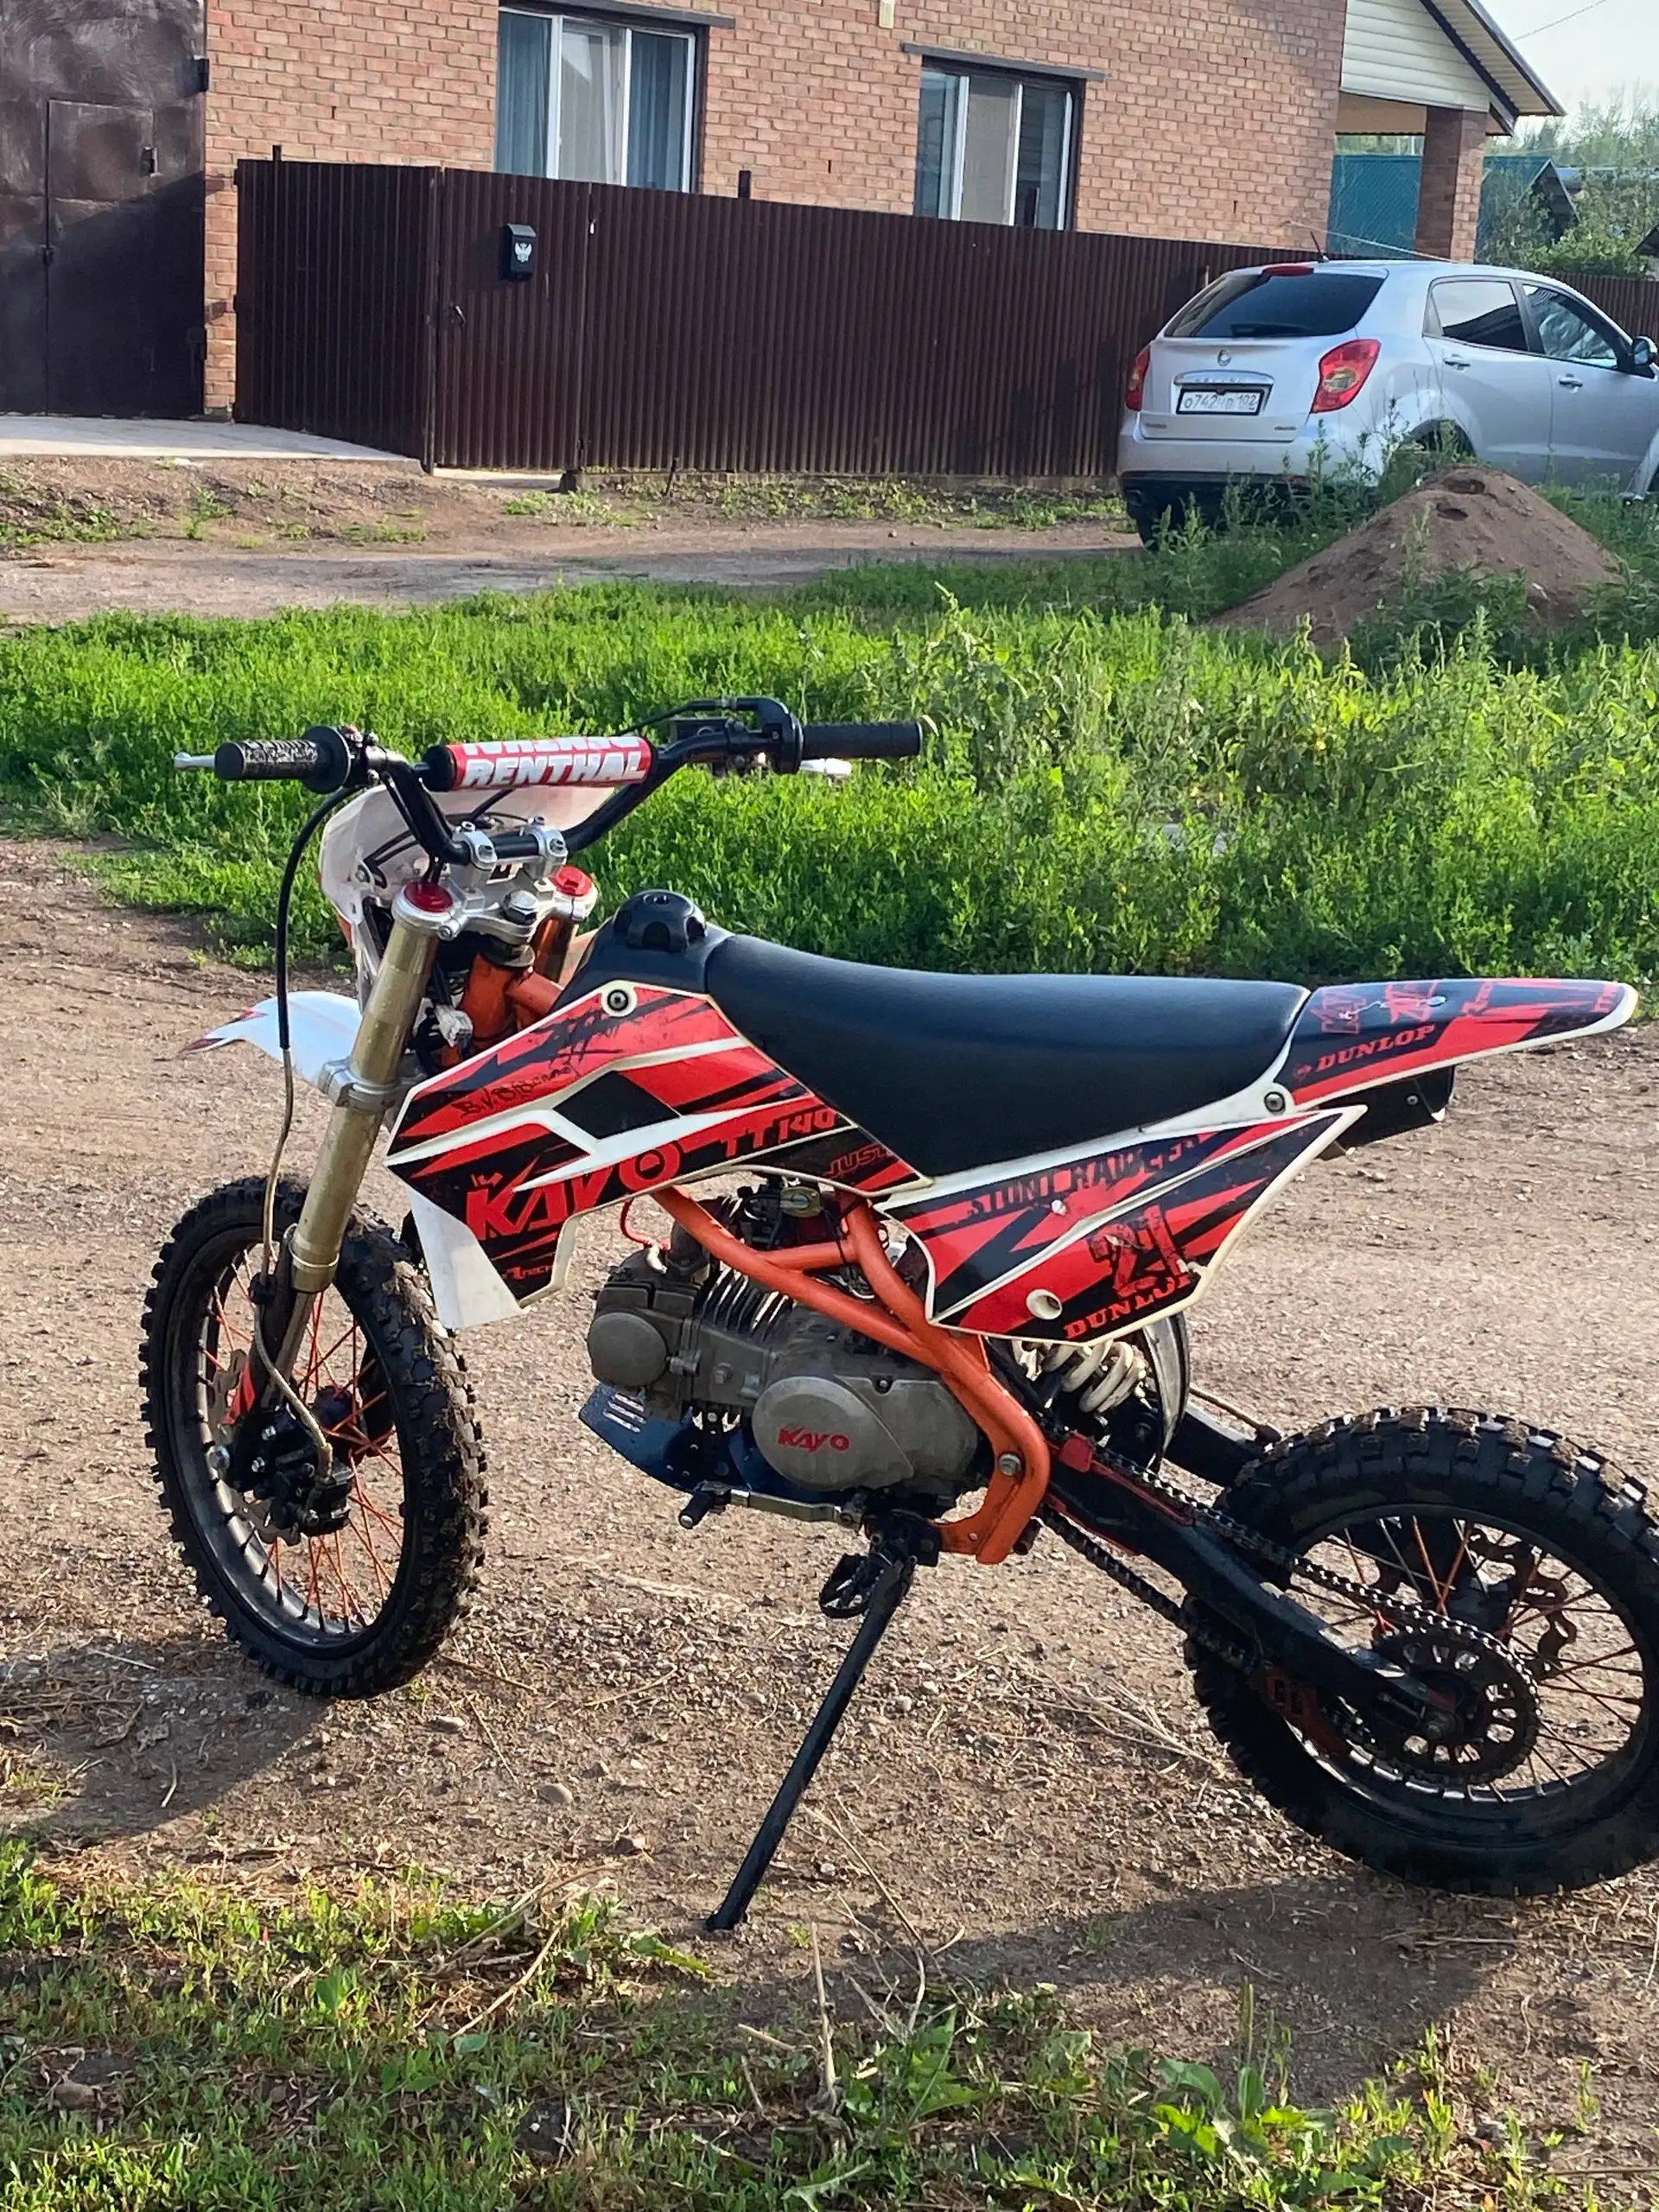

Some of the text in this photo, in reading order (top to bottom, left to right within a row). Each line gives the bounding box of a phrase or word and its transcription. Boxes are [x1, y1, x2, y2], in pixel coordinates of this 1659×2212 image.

[462, 750, 646, 788] RENTHAL
[1316, 1023, 1435, 1071] DUNLOP
[777, 1424, 851, 1452] KAYO
